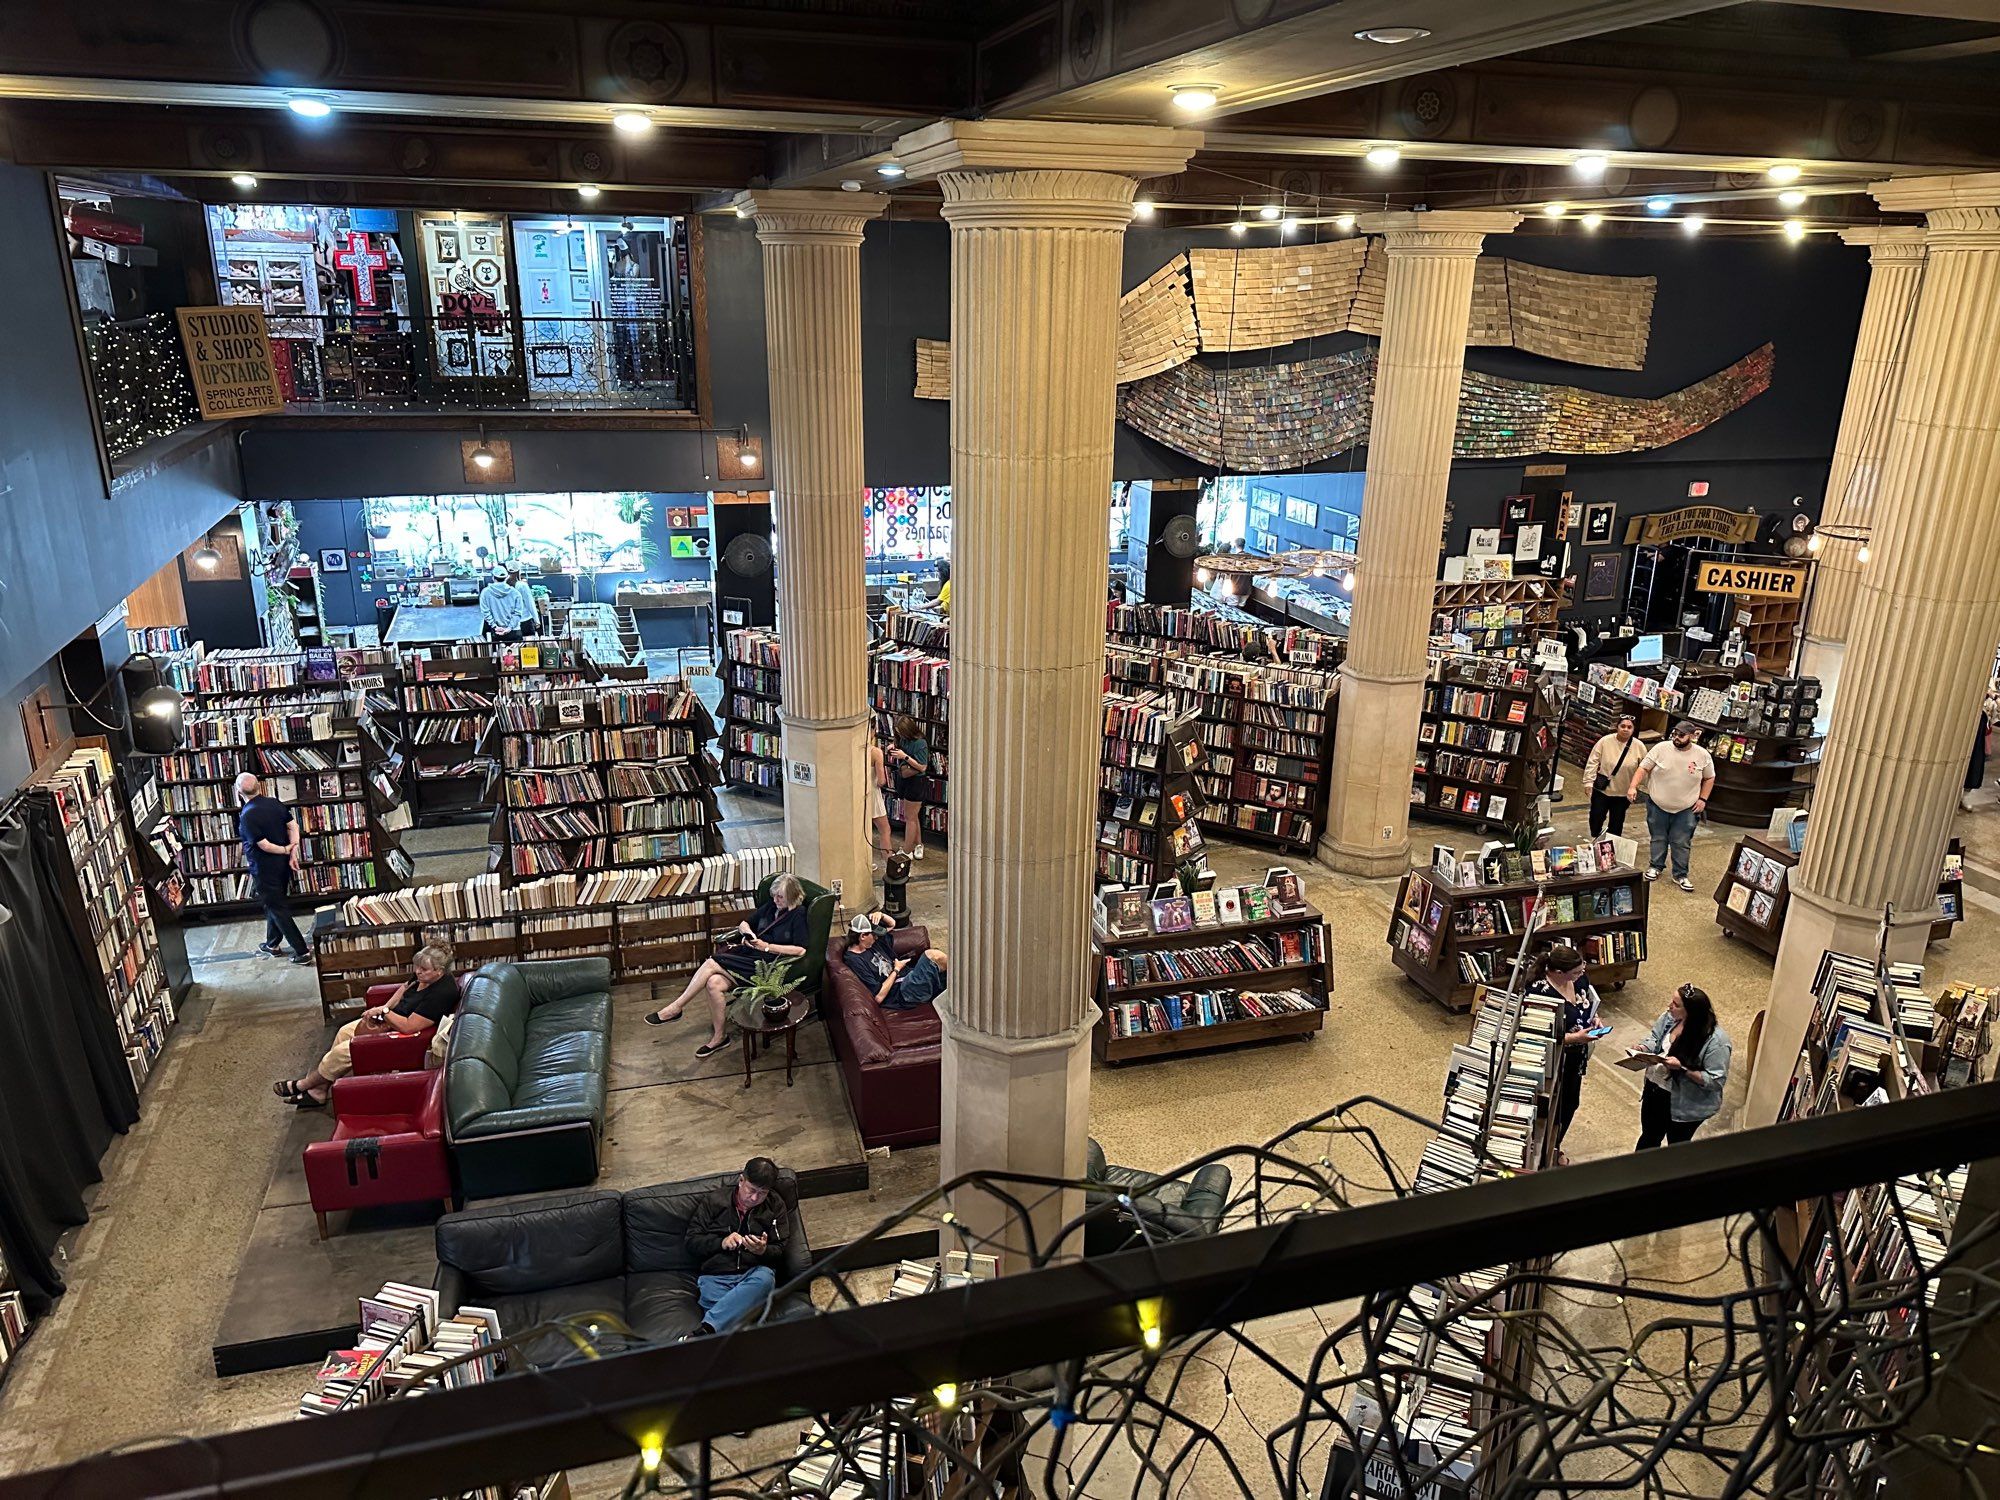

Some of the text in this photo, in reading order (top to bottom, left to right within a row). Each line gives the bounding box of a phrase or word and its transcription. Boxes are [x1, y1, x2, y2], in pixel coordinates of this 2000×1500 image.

[443, 294, 496, 311] DOVE
[188, 314, 259, 337] STUDIOS
[196, 338, 264, 361] & SHOPS
[200, 361, 270, 385] UPSTAIRS
[206, 385, 274, 400] SPRING ARTS
[209, 396, 276, 411] COLLECTIVE
[1658, 508, 1738, 527] THANK YOU FOR VISITING
[1661, 523, 1675, 536] THE
[1676, 520, 1693, 531] LAST
[1693, 519, 1731, 536] BOOKSTORE
[1707, 568, 1796, 593] CASHIER
[1292, 651, 1313, 662] DRAMA
[1544, 643, 1559, 654] FILM
[686, 666, 710, 676] CRAFTS
[1172, 673, 1189, 685] MUSIC
[351, 676, 383, 690] MEMOIRS
